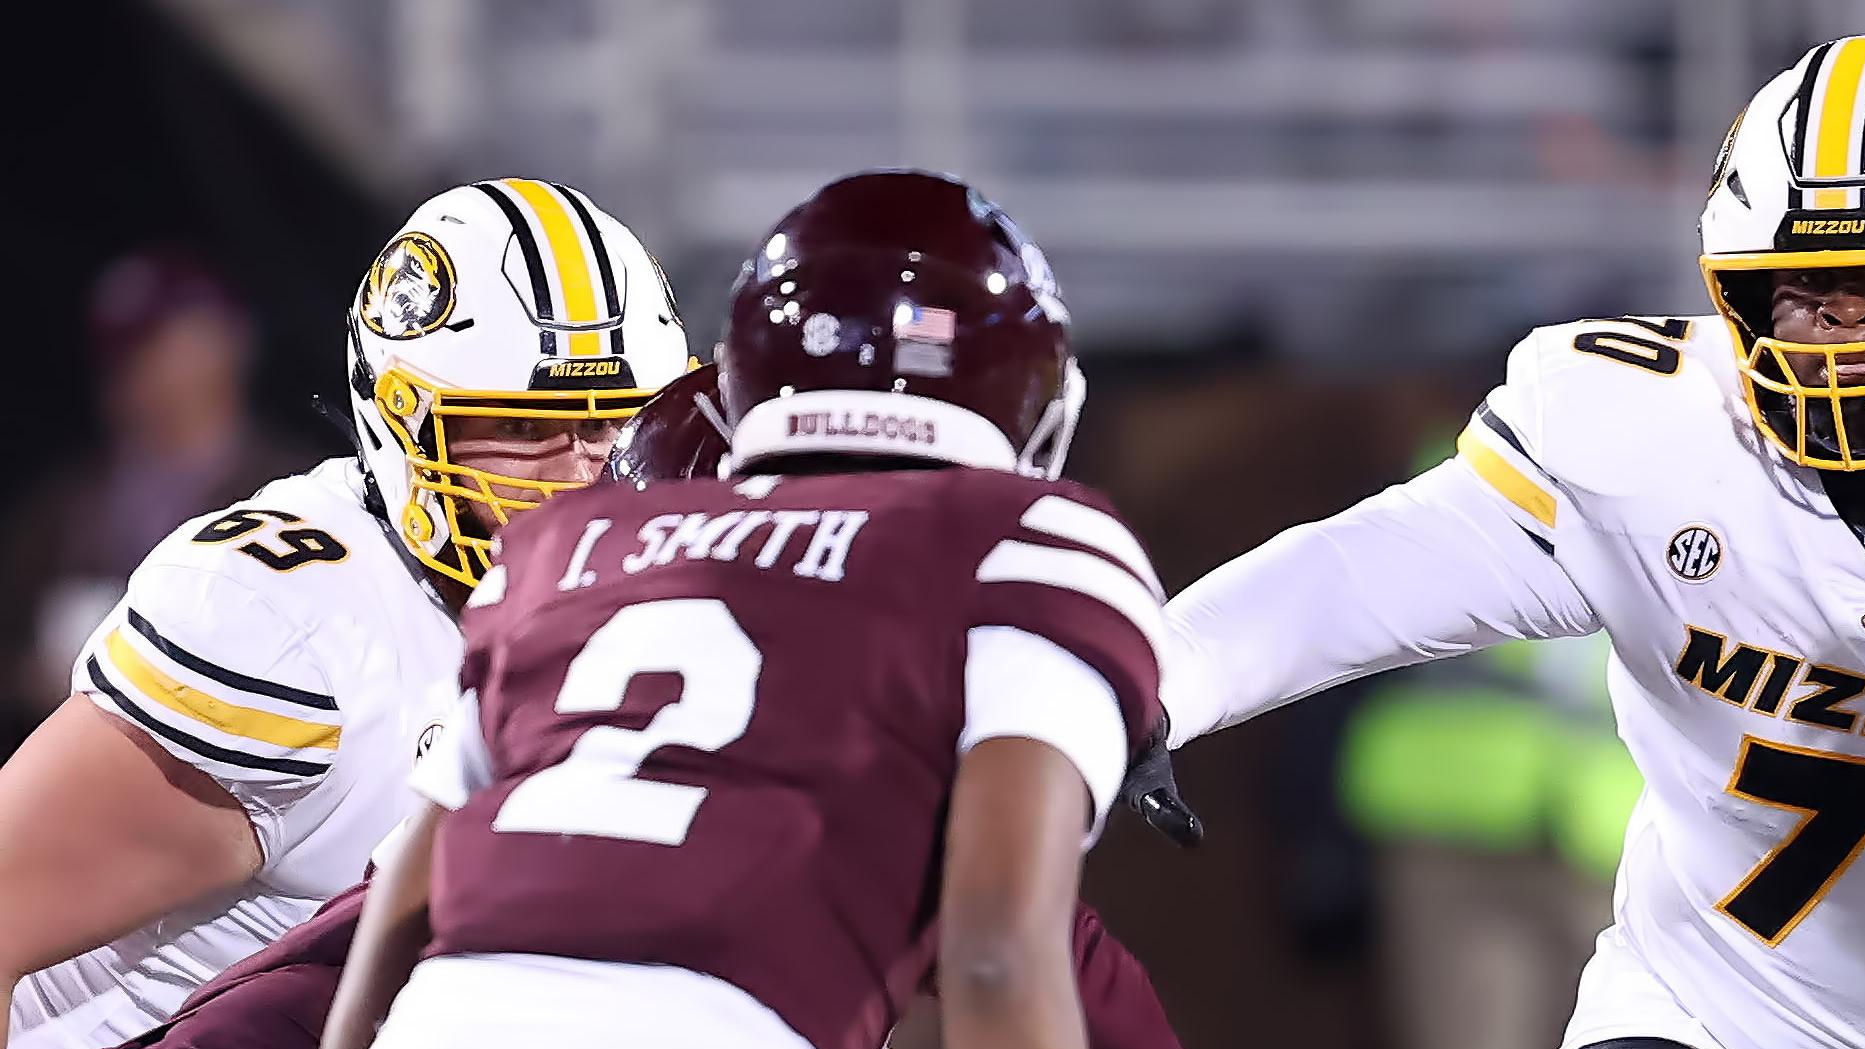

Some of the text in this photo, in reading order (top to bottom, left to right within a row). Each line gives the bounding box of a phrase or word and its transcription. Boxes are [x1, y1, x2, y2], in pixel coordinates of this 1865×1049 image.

[549, 360, 621, 378] MIZZOU
[1571, 317, 1694, 377] 70
[787, 410, 936, 444] BULLDOGS
[190, 508, 352, 575] 69
[621, 510, 870, 581] SMITH
[1671, 529, 1719, 576] SEC
[490, 598, 764, 847] 2
